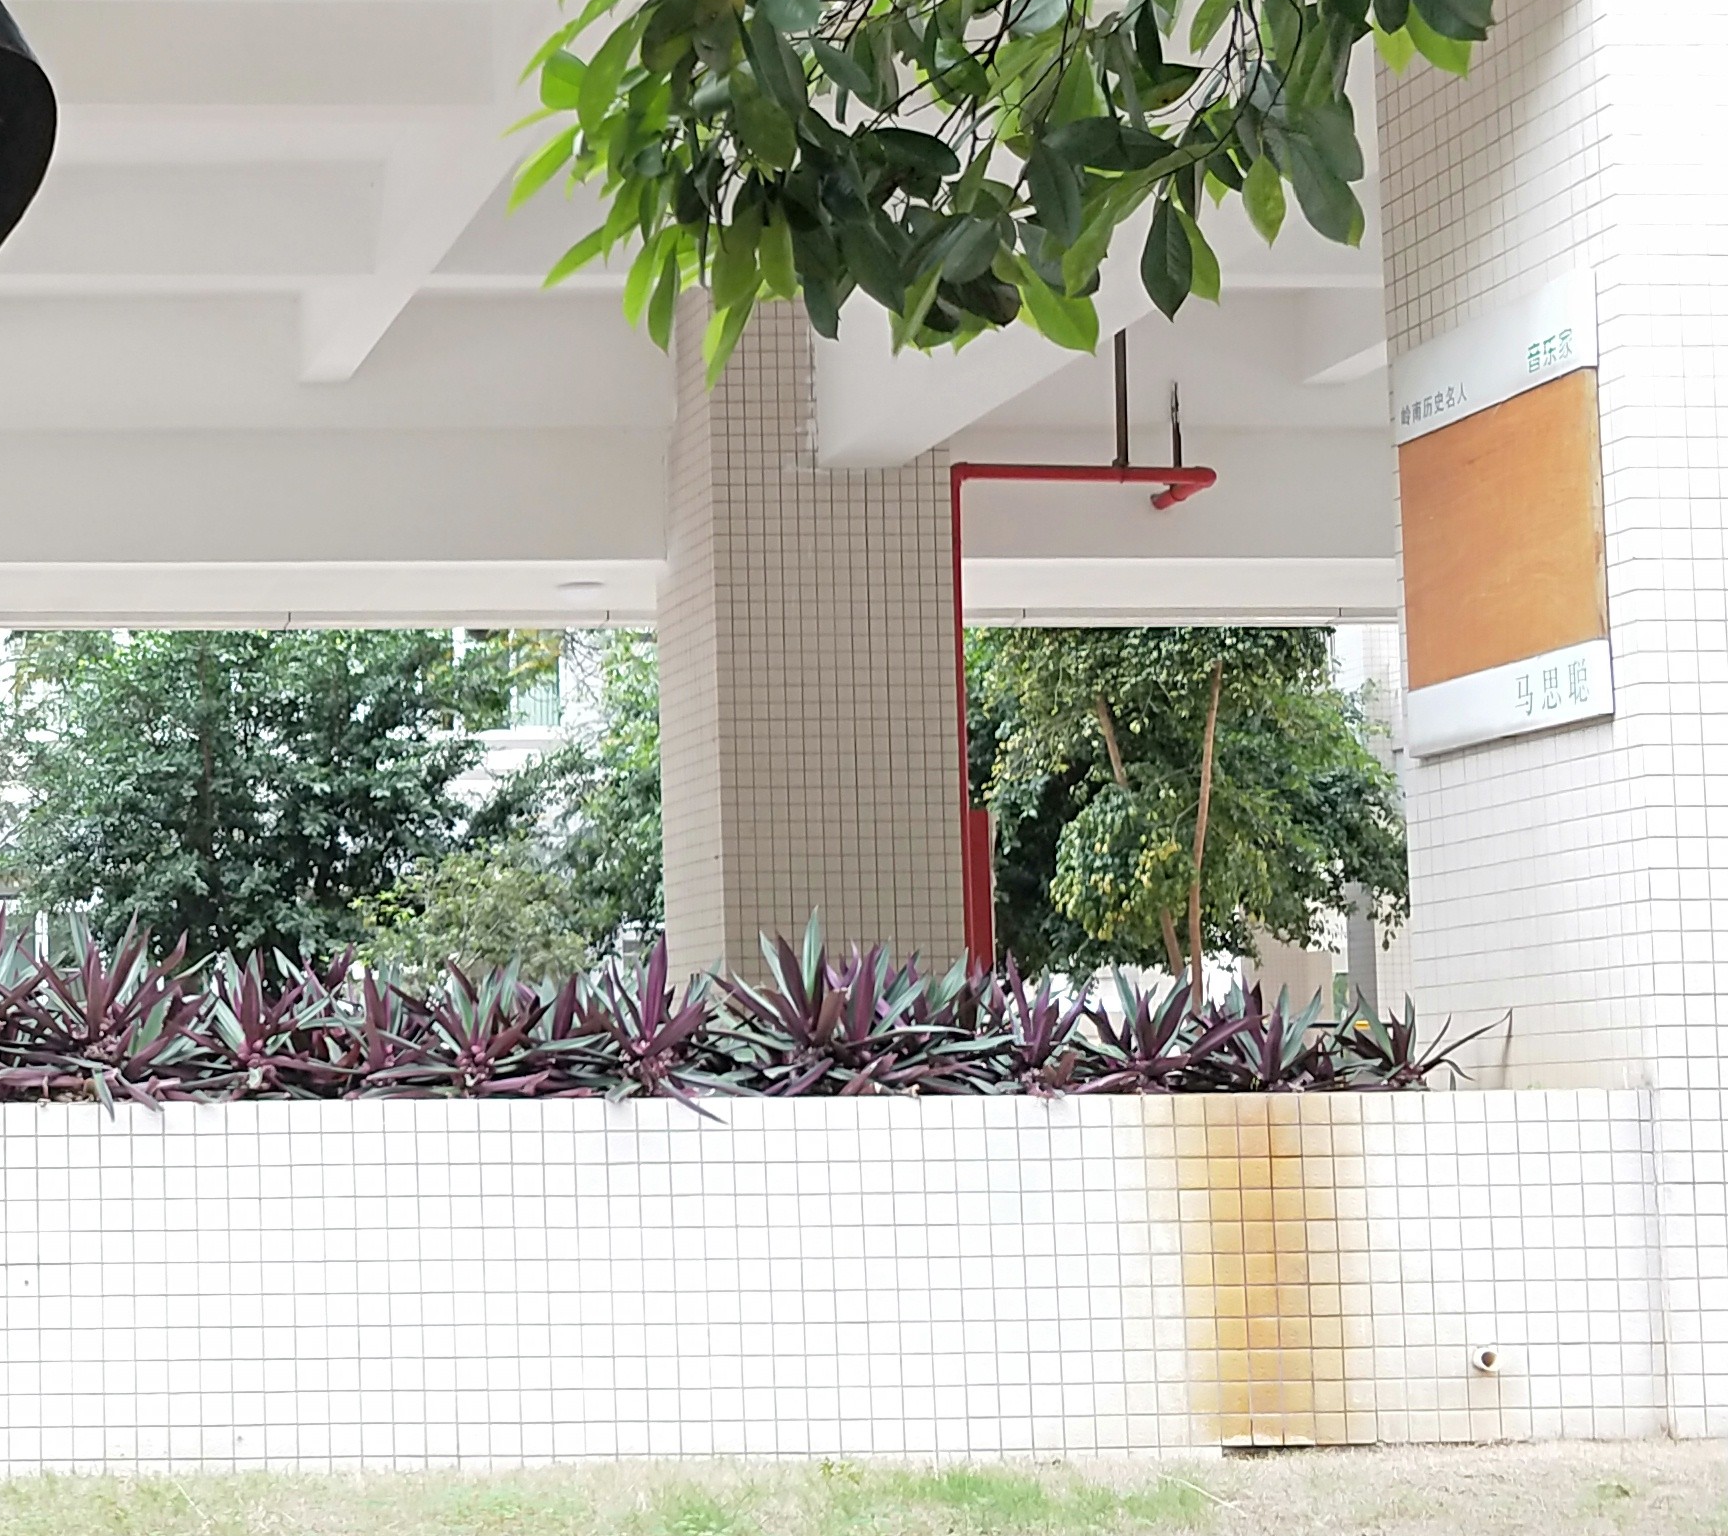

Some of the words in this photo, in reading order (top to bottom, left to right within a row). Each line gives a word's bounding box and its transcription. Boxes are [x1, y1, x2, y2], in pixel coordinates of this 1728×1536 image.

[1528, 328, 1572, 373] 音乐家
[1400, 382, 1468, 426] 岭南历史名人
[1514, 658, 1590, 716] 马思聪
